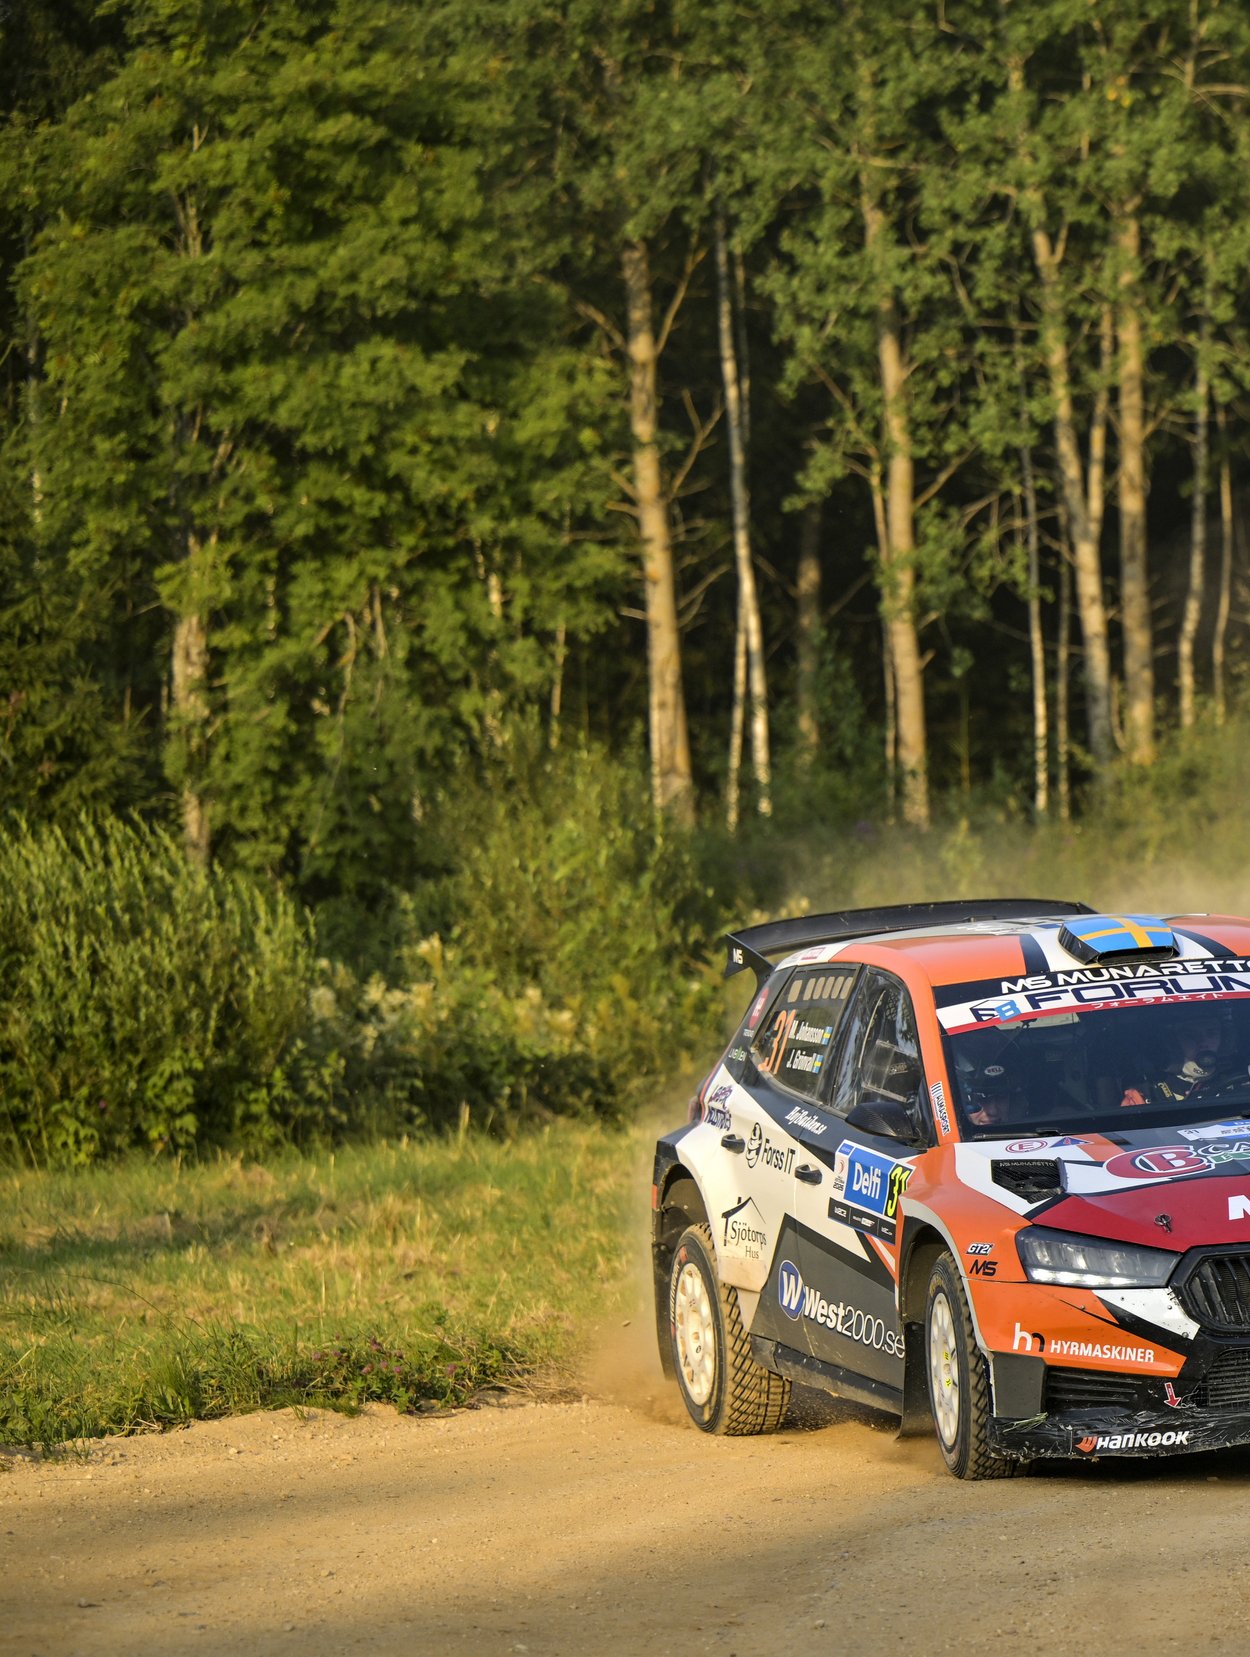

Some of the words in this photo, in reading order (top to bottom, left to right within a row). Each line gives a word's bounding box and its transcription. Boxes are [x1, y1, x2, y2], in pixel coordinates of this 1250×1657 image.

[1002, 975, 1052, 994] MS
[1091, 992, 1224, 1009] フォーラムエイト
[758, 1009, 796, 1075] 31
[761, 1138, 785, 1171] Forss
[784, 1148, 796, 1174] IT
[853, 1162, 882, 1199] Delfi
[887, 1167, 910, 1216] 31
[730, 1221, 767, 1250] Sjötorps
[745, 1246, 760, 1259] Hus
[969, 1259, 998, 1276] MS
[804, 1285, 905, 1358] West2000.se
[1050, 1340, 1155, 1363] HYRMASKINER
